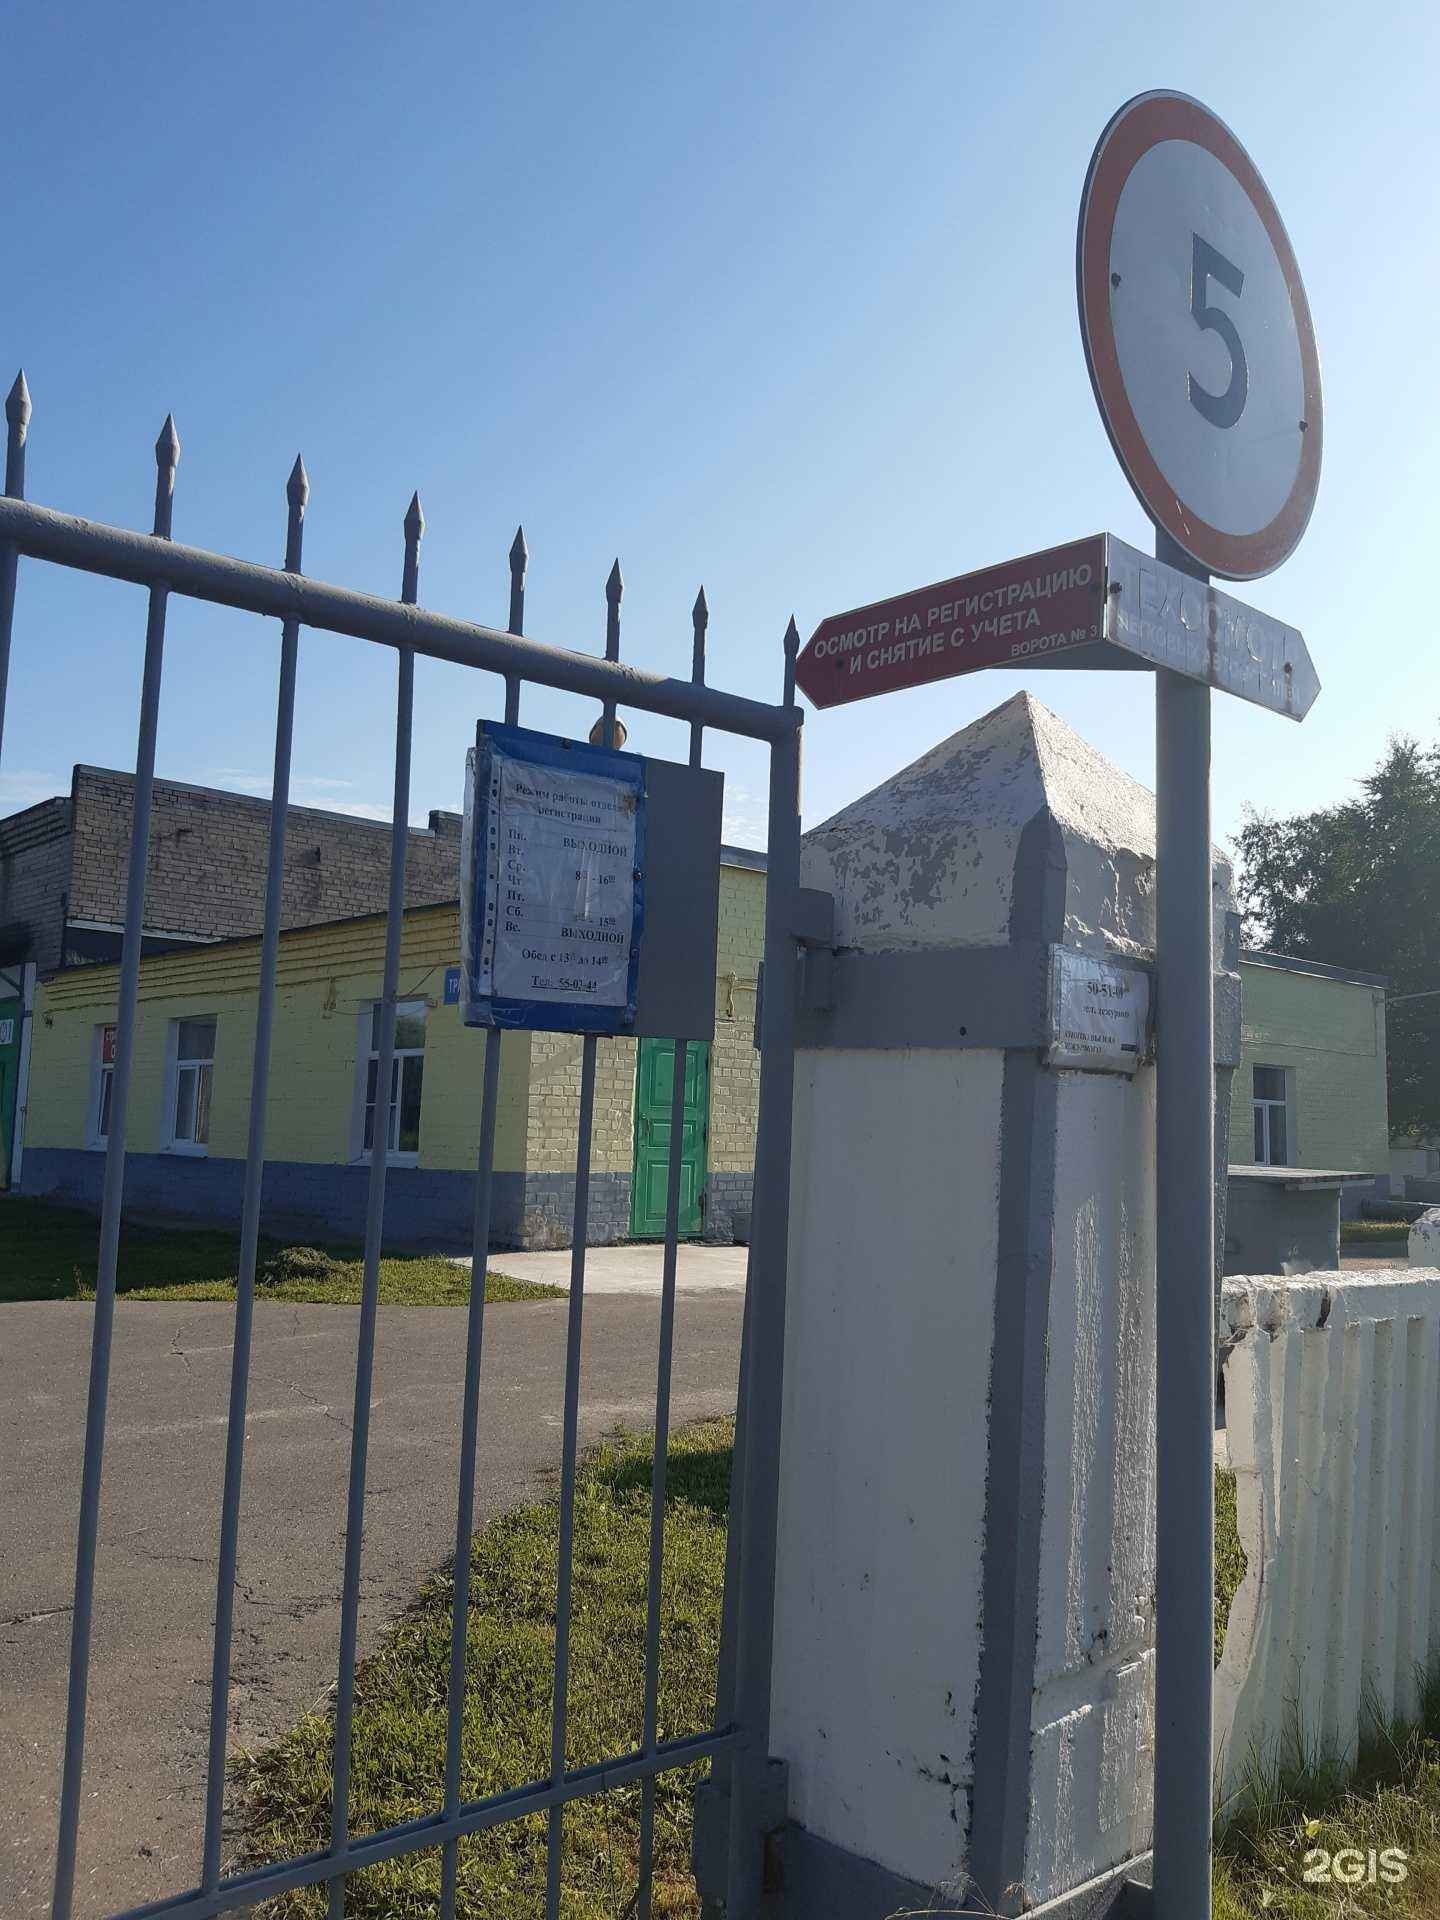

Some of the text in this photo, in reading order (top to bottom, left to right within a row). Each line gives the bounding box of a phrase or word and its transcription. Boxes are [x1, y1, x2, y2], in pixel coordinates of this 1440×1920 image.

[1188, 232, 1248, 429] 5
[814, 564, 1092, 659] ОСМОТР НА РЕГИСТРАЦИЮ
[849, 608, 1041, 674] И СНЯТИЕ С УЧЕТА
[1011, 625, 1098, 657] ВОРОТА № 3
